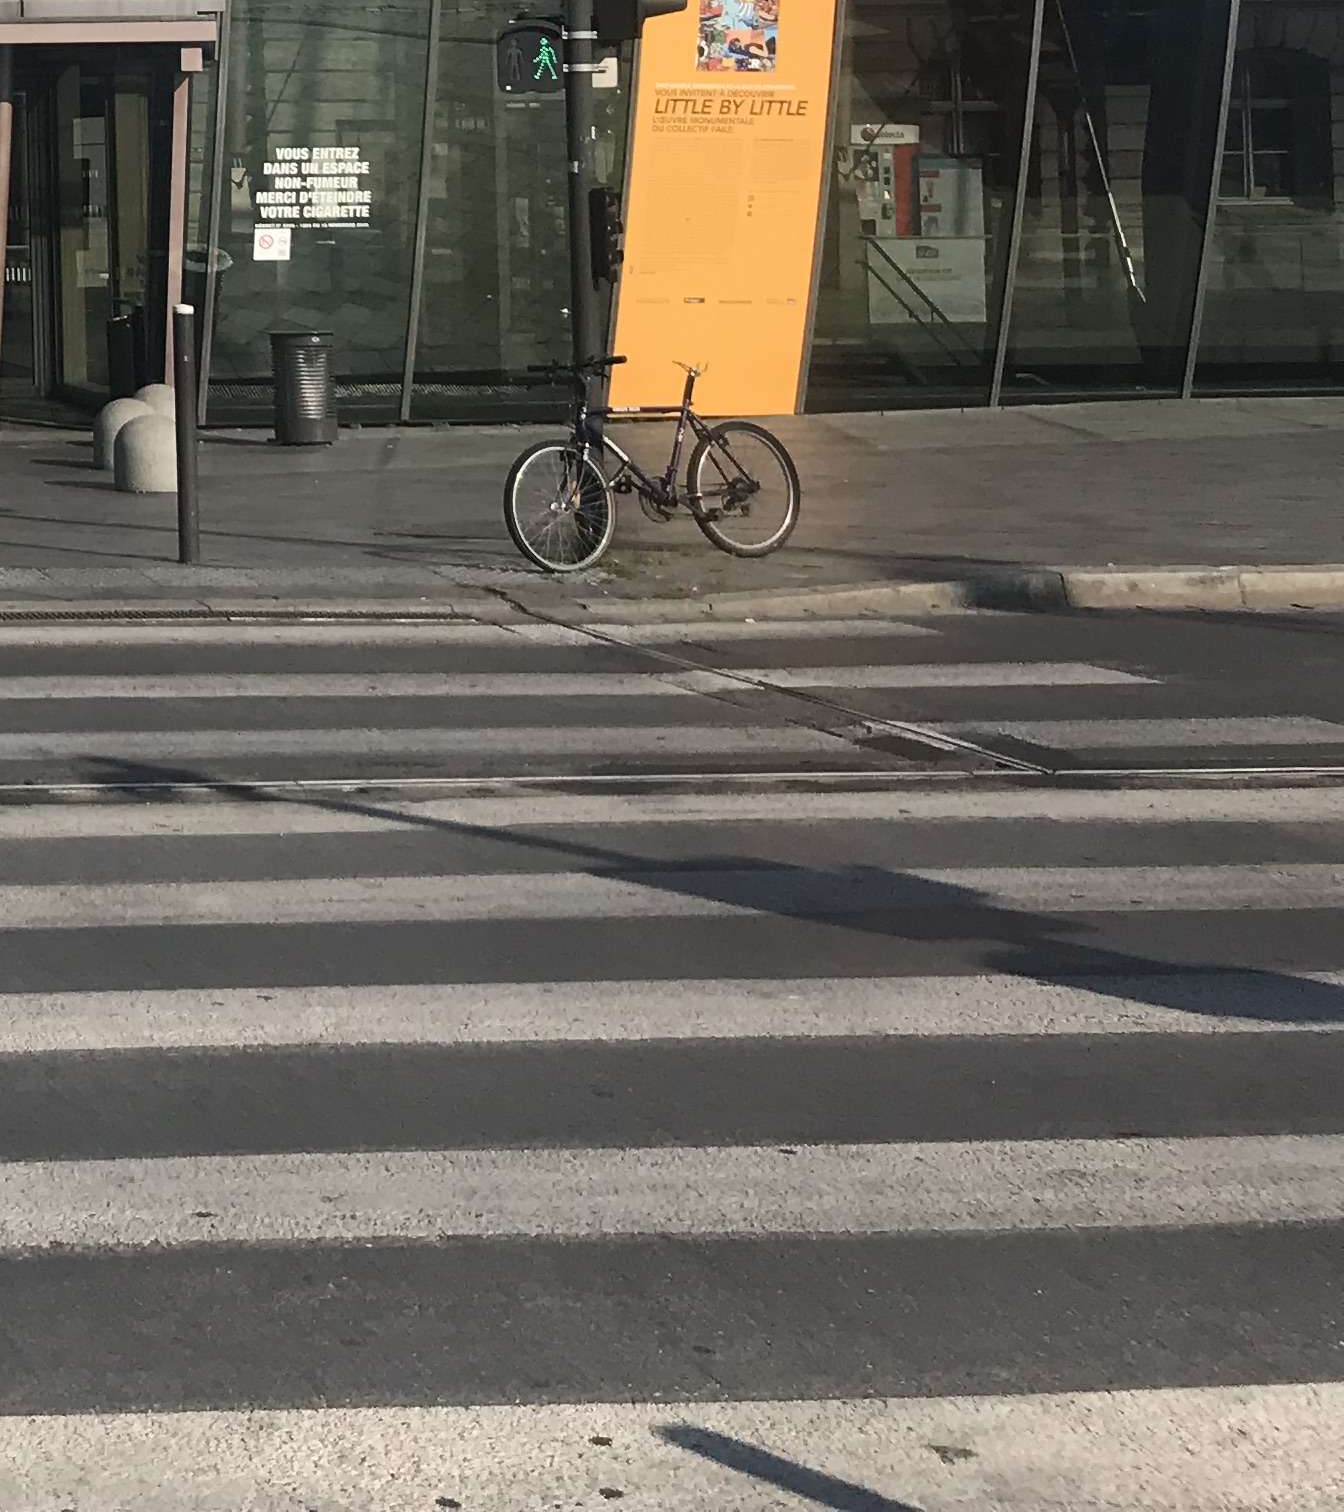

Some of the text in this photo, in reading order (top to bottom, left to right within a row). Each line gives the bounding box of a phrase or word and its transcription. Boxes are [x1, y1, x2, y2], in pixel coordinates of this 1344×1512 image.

[654, 98, 809, 116] LITTLE BY LITTLE
[275, 147, 360, 160] VOUS ENTREZ
[263, 161, 370, 175] DANS UN ESPACE
[274, 176, 359, 189] NON-FUMEUR
[255, 191, 296, 204] MERCI
[260, 205, 370, 219] VOTRE CIGARETTE
